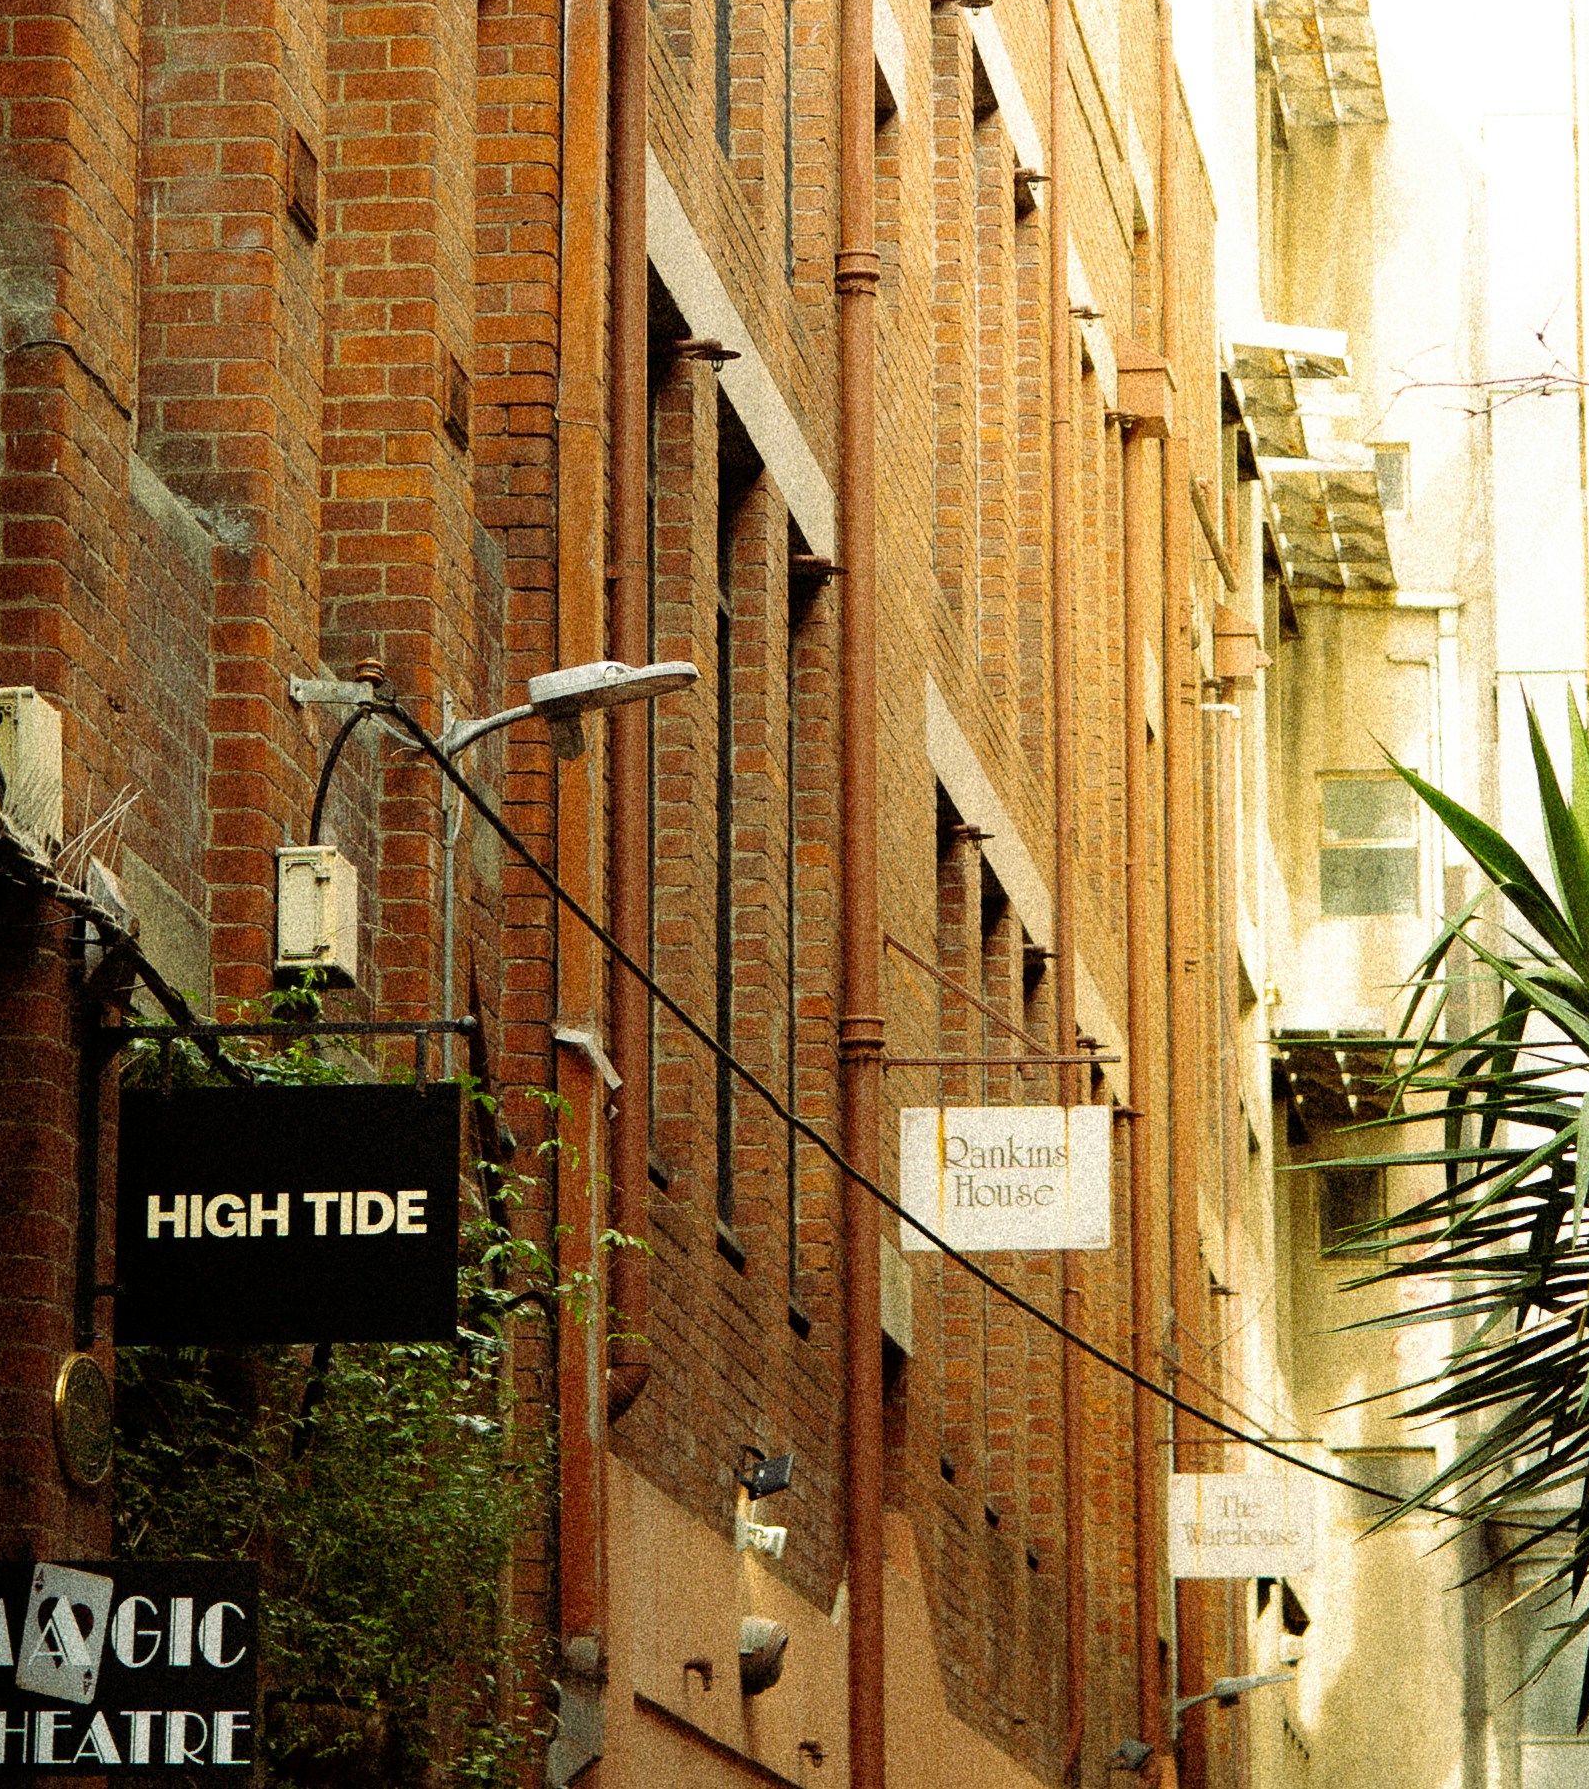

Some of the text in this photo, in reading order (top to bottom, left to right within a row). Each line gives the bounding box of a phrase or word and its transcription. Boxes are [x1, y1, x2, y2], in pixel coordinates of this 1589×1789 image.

[942, 1133, 1068, 1169] Rankins
[952, 1173, 1056, 1208] House
[146, 1189, 429, 1239] HIGH TIDE
[1217, 1494, 1262, 1519] The
